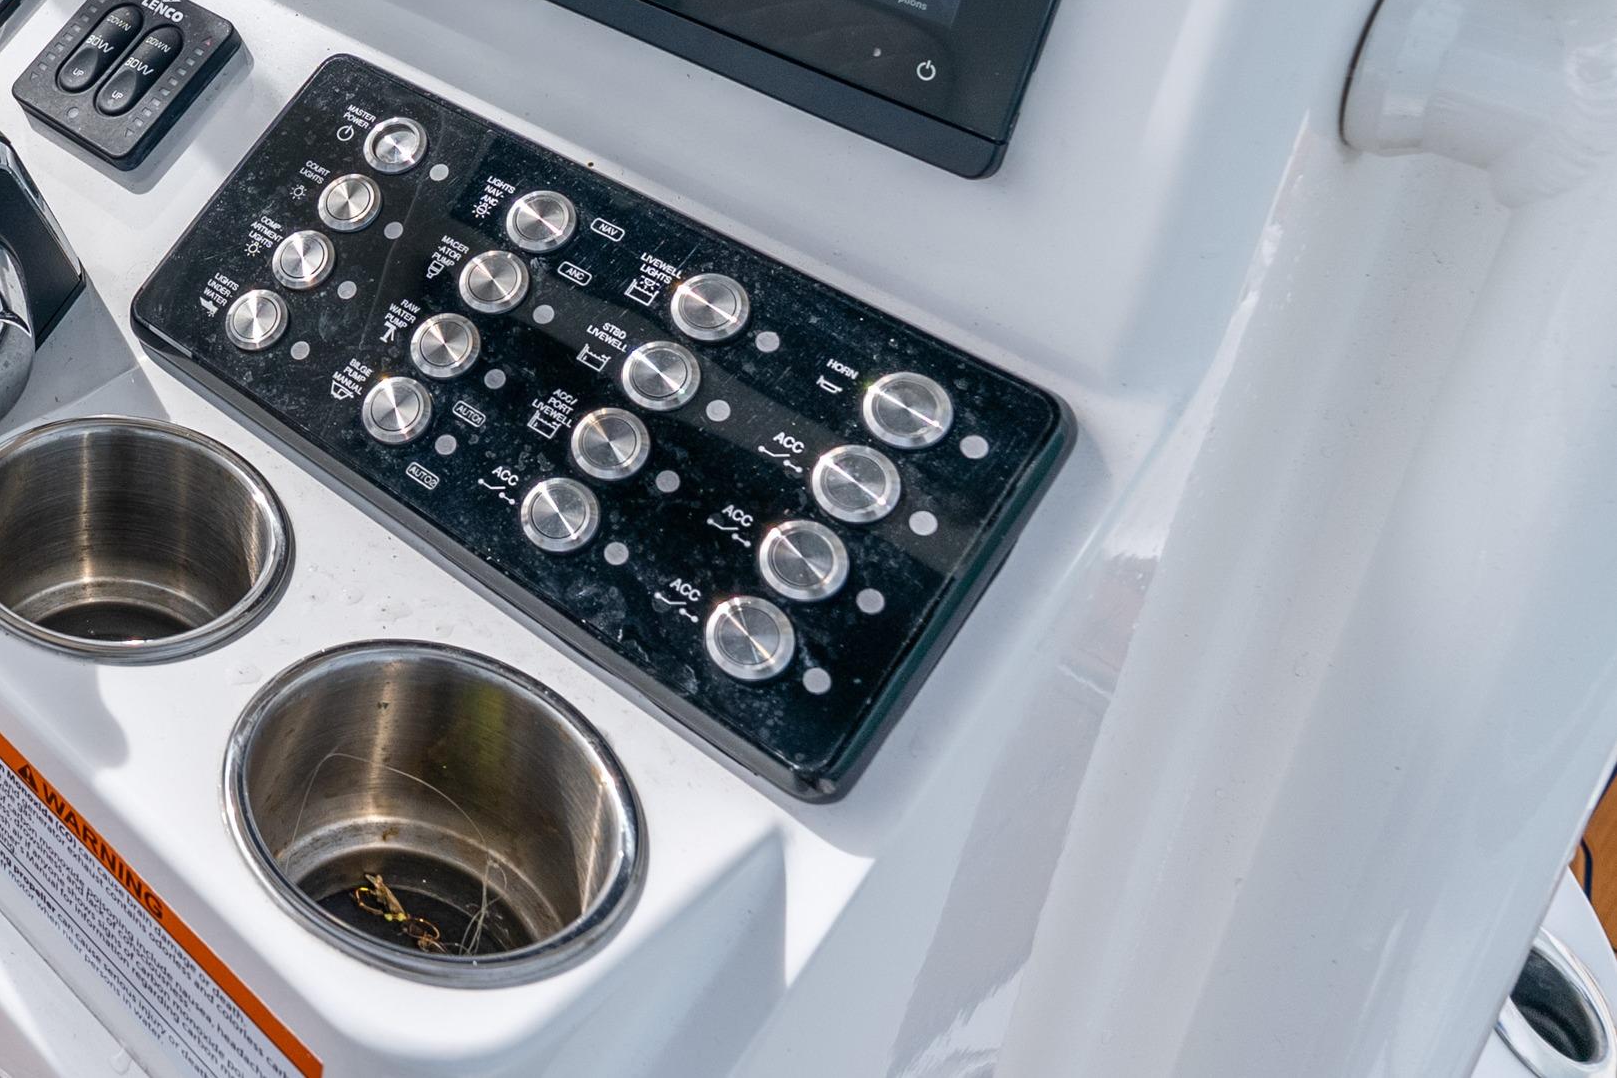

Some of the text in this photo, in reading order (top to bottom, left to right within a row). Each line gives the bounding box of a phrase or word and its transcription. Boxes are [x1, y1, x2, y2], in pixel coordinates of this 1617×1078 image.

[106, 14, 132, 32] DOWN
[86, 33, 114, 54] BOW
[145, 35, 171, 54] DOWN
[73, 67, 84, 77] UP
[125, 56, 154, 76] BOW
[111, 90, 123, 100] UP
[343, 112, 369, 129] POWER
[347, 104, 376, 123] MASTER
[299, 168, 324, 185] LIGHTS
[306, 160, 330, 176] COURT
[484, 185, 504, 199] NAV-
[487, 175, 516, 194] LIGHTS
[480, 194, 499, 207] ANC
[249, 230, 273, 248] LIGHTS
[250, 221, 283, 242] ARTMENT
[598, 223, 618, 236] NAV
[441, 235, 469, 254] MACER
[432, 252, 455, 269] PUMP
[641, 252, 683, 280] LIVEWELL
[214, 273, 239, 290] LIGHTS
[566, 268, 585, 281] ANC
[640, 264, 671, 285] LIGHTS
[203, 287, 227, 306] WATER
[401, 298, 421, 314] RAW
[385, 313, 408, 330] PUMP
[389, 304, 416, 324] WATER
[587, 325, 628, 353] LIVEWELL
[603, 322, 627, 340] STBD
[343, 366, 367, 383] PUMP
[349, 358, 373, 377] BILGE
[826, 358, 858, 380] HORN
[333, 371, 363, 396] MANUAL
[547, 396, 573, 415] PORT
[552, 388, 578, 406] ACC/
[456, 404, 483, 424] AUTO1
[532, 398, 573, 429] LIVEWELL
[773, 431, 805, 454] ACC
[491, 465, 519, 487] ACC
[722, 504, 754, 528] ACC
[669, 577, 701, 602] ACC
[43, 783, 163, 923] WARNING
[7, 770, 53, 824] Monoxide
[55, 821, 76, 850] (CO)
[97, 867, 123, 899] cause
[126, 894, 151, 928] brain
[154, 927, 196, 976] damage
[7, 803, 37, 839] carbon
[39, 837, 84, 889] monoxide
[87, 887, 133, 943] poisoning
[136, 938, 173, 983] include
[175, 982, 214, 1029] nausea,
[13, 819, 64, 877] drowsiness,
[86, 894, 103, 918] lack
[118, 930, 190, 1012] consciousness.
[8, 869, 33, 901] motor
[36, 901, 60, 930] when
[62, 929, 81, 955] near
[84, 954, 120, 998] persons
[22, 799, 64, 848] generator
[67, 846, 103, 888] exhaust
[105, 886, 146, 934] contains
[148, 932, 191, 982] odorless
[216, 1003, 263, 1058] colorless
[13, 865, 56, 916] propeller
[75, 931, 101, 965] cause
[103, 963, 136, 1004] serious
[139, 999, 165, 1037] injury
[26, 851, 58, 892] Manual
[75, 904, 129, 969] information
[131, 966, 179, 1025] regarding
[181, 1021, 218, 1067] carbon
[32, 849, 65, 888] anyone
[67, 886, 95, 921] shows
[97, 918, 121, 949] signs
[135, 959, 170, 1002] carbon
[172, 999, 225, 1063] monoxide
